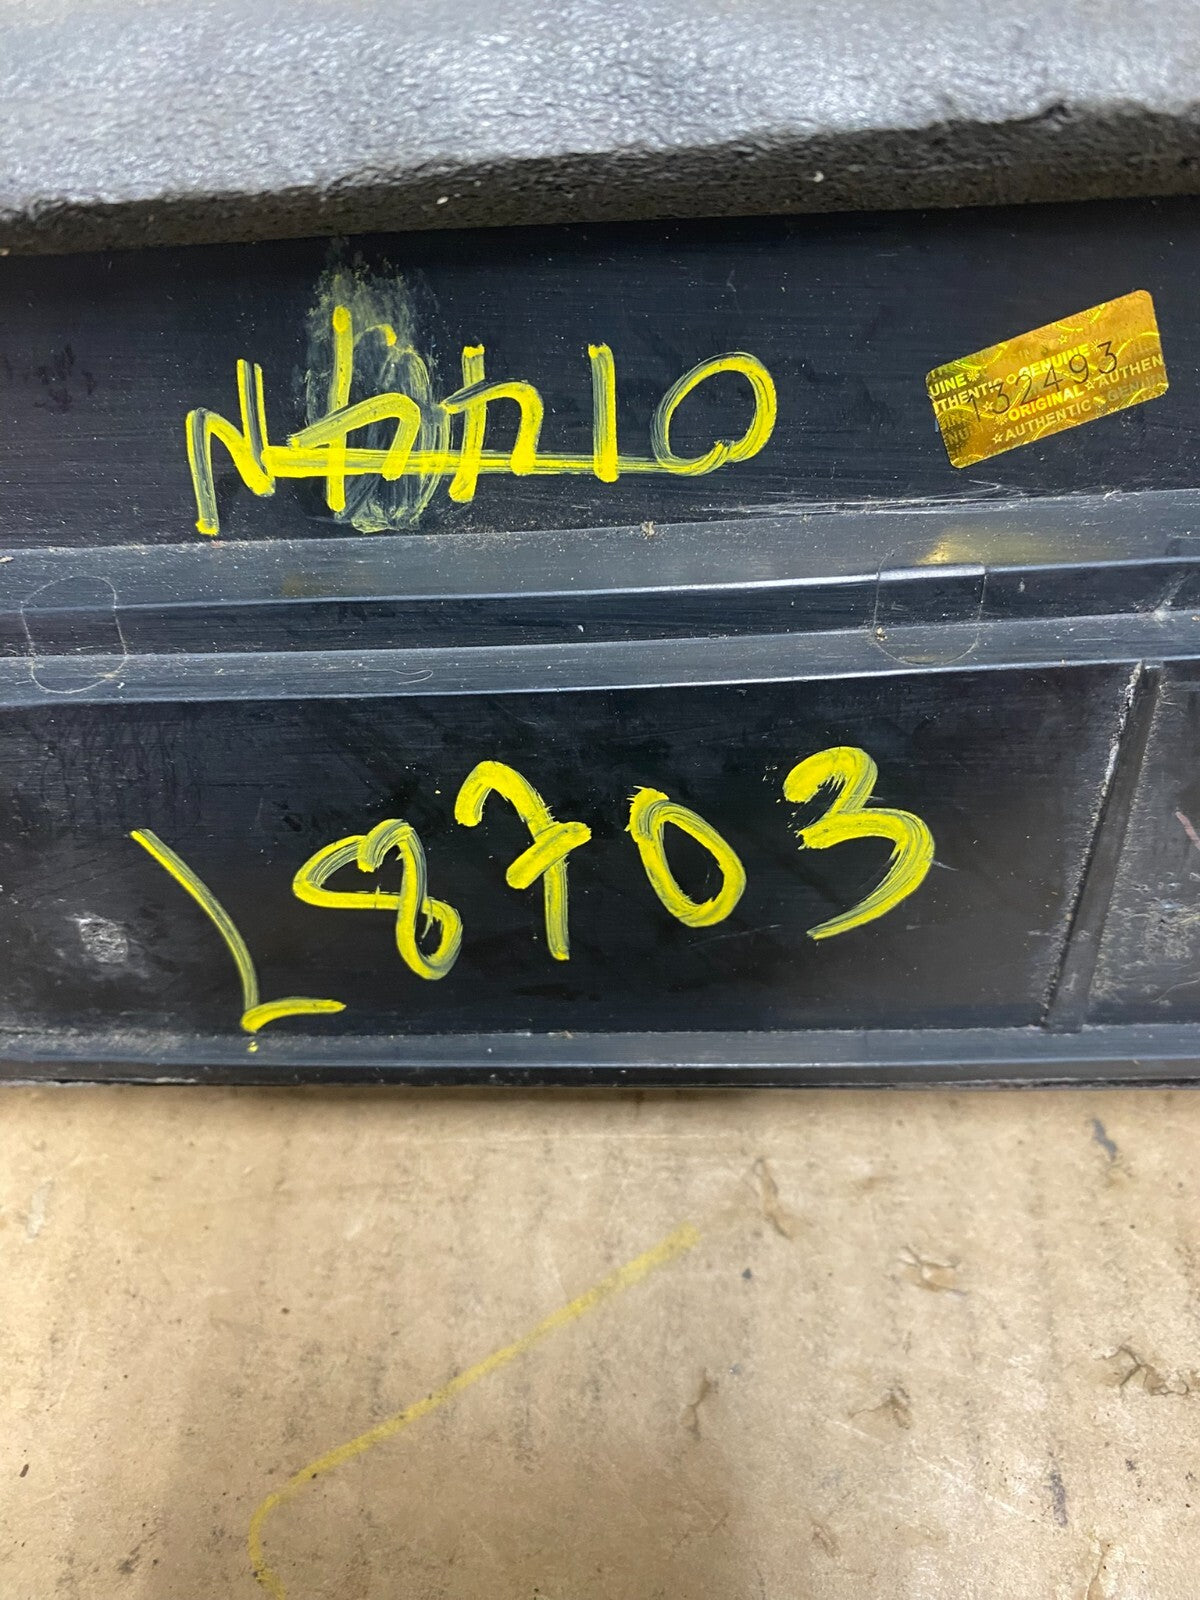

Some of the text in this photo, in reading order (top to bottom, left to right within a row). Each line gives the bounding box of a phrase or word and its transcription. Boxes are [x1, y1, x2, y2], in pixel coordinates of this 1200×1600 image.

[1017, 343, 1091, 379] GENUINE
[967, 340, 1118, 422] 132493
[1004, 400, 1092, 442] AUTHENTIC
[1008, 384, 1085, 421] ORIGINAL
